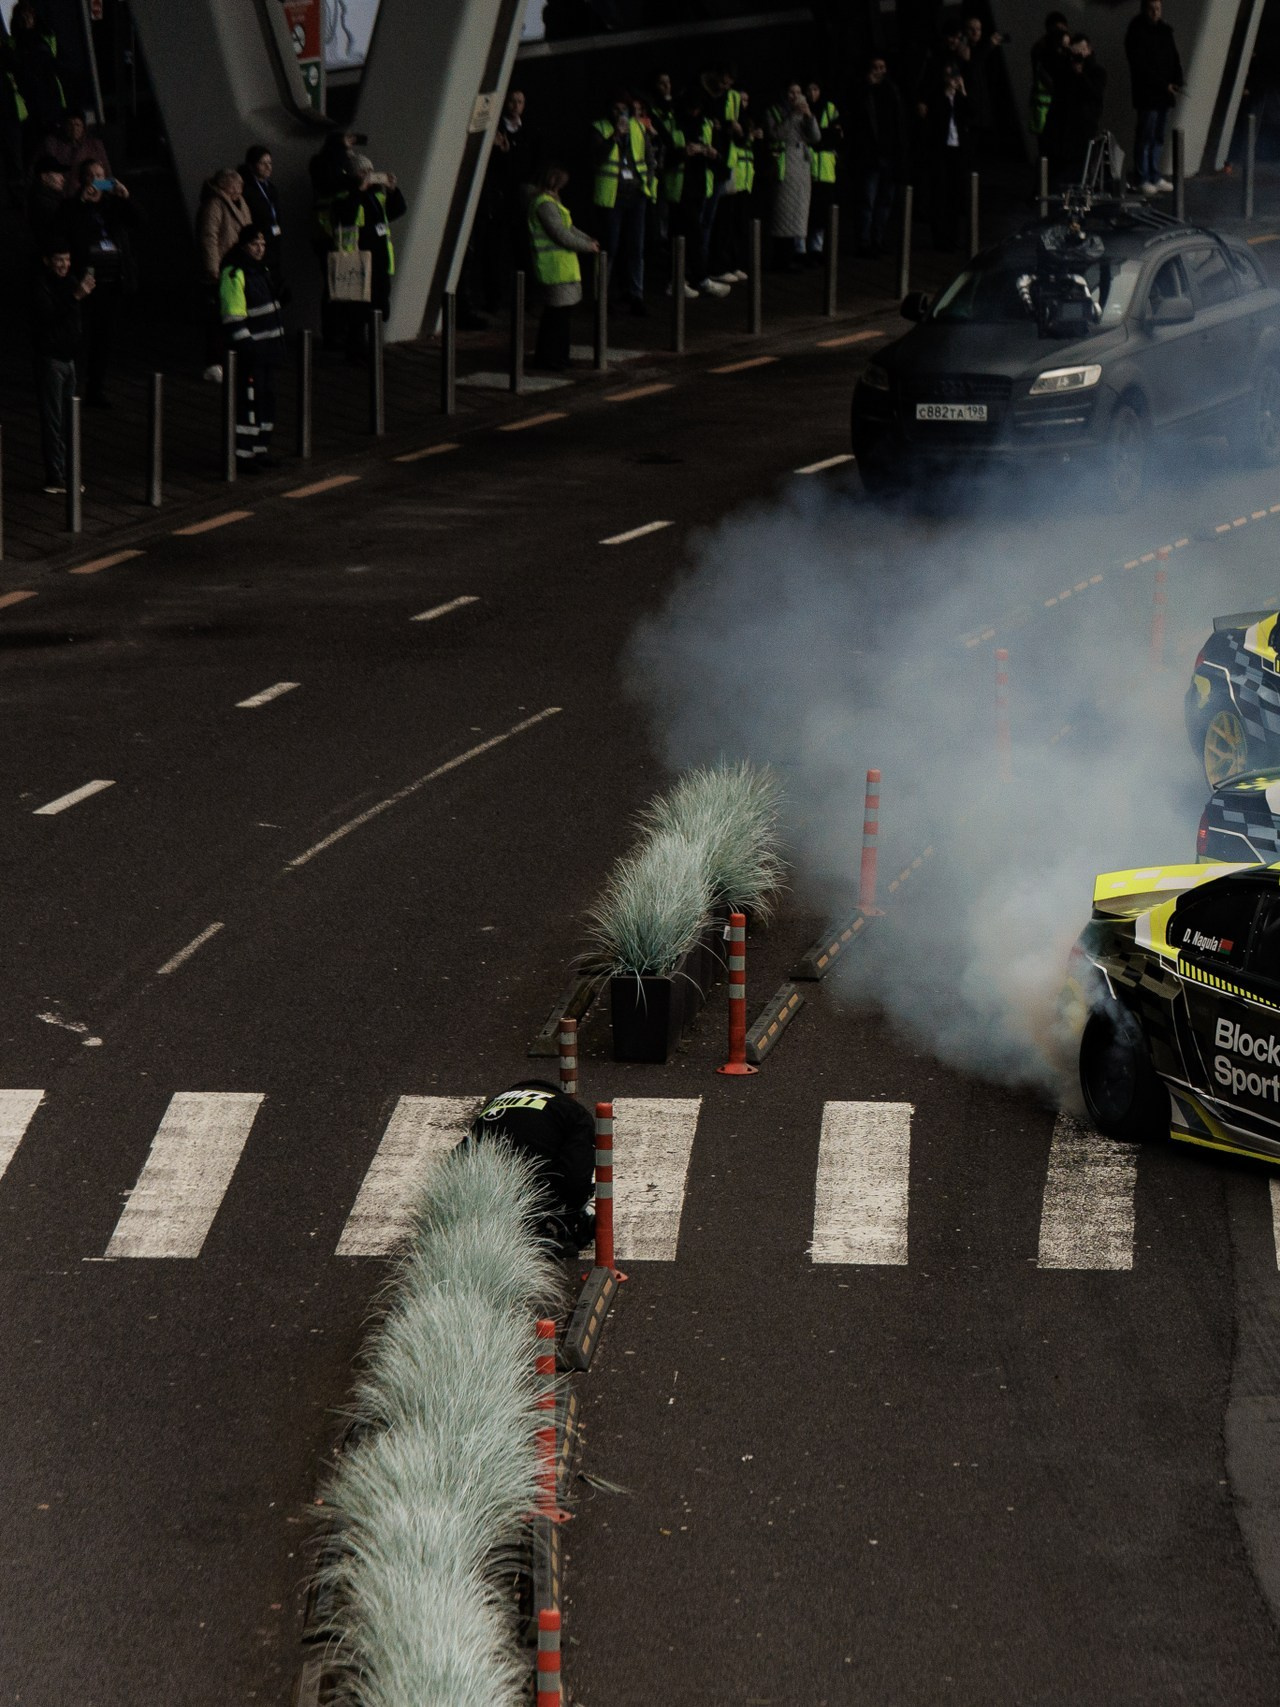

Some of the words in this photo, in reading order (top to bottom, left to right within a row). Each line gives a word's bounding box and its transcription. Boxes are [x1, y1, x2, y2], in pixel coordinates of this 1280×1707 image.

[967, 406, 985, 417] 198
[1182, 928, 1192, 943] D.
[1191, 930, 1219, 951] Nagula
